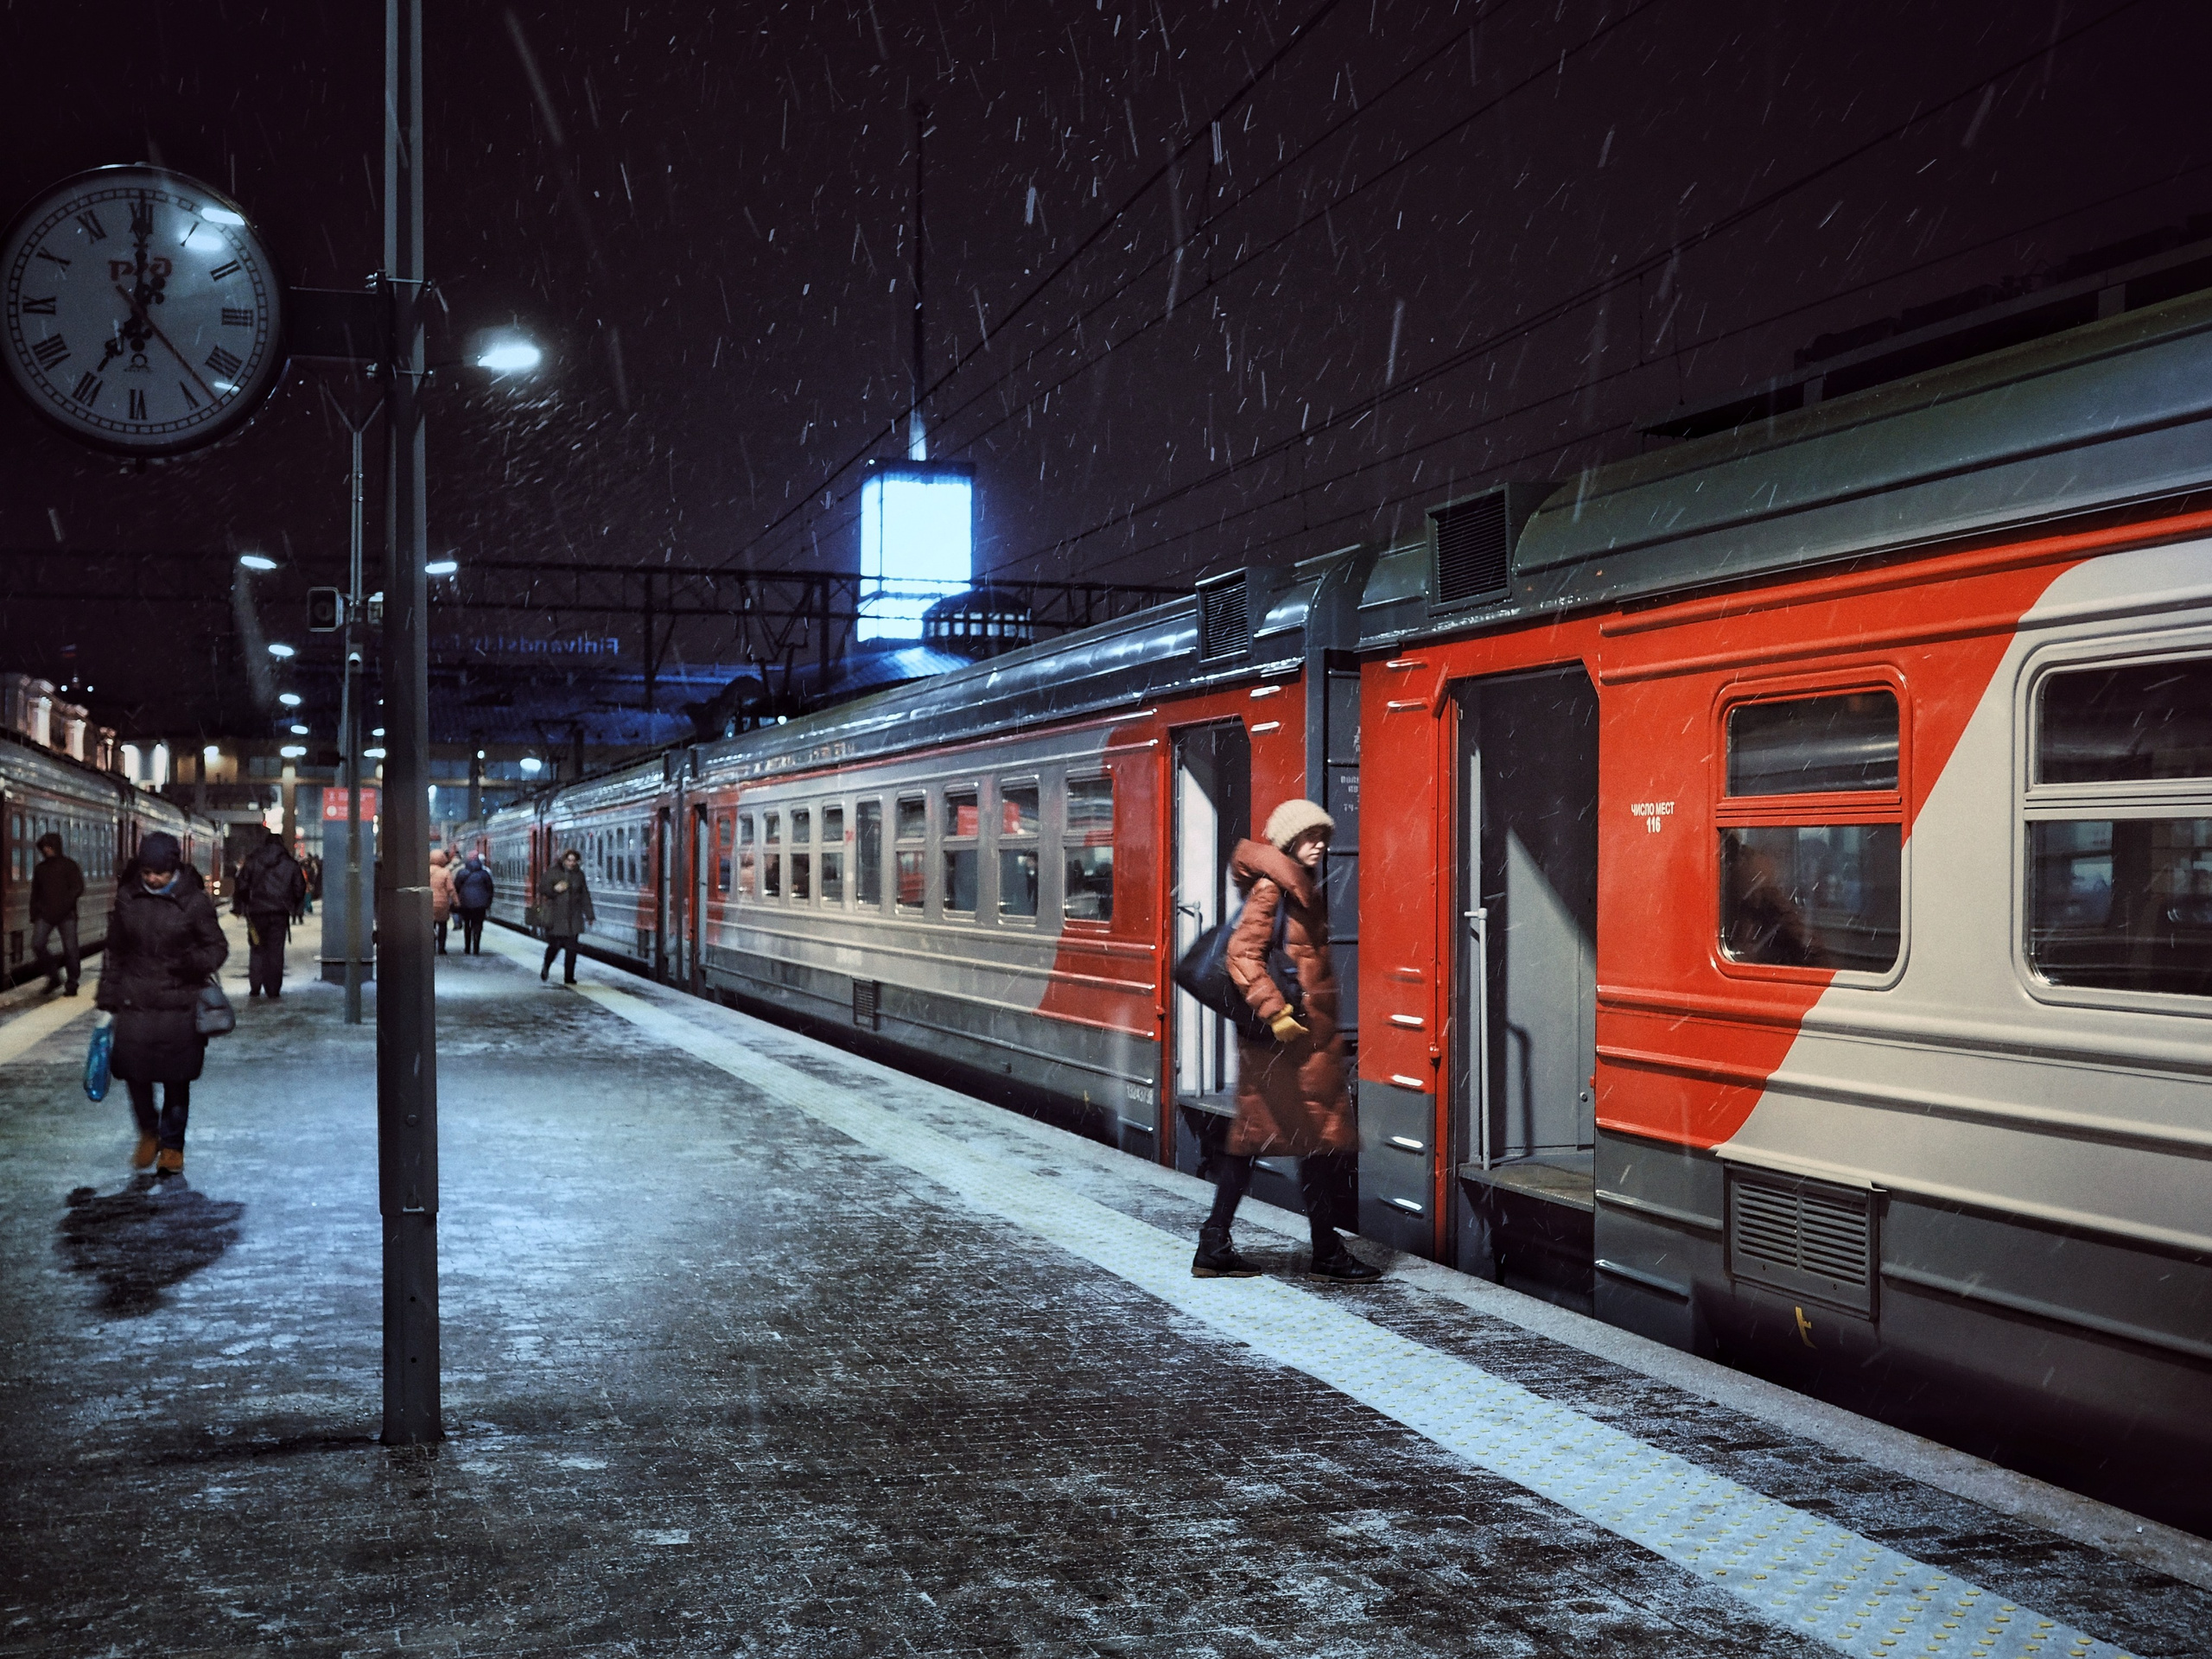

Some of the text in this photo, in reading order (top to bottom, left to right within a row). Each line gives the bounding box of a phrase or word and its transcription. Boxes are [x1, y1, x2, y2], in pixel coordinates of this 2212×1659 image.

[77, 209, 108, 244] XI
[181, 221, 200, 246] I
[36, 247, 71, 272] X
[210, 259, 242, 282] II
[22, 296, 56, 315] IX
[221, 308, 254, 327] III
[32, 334, 71, 372] VIII
[72, 372, 104, 407] VII
[180, 380, 200, 411] V
[130, 389, 148, 420] VI
[1630, 802, 1675, 817] ЧИСЛО МЕСТ
[1646, 816, 1661, 833] 116
